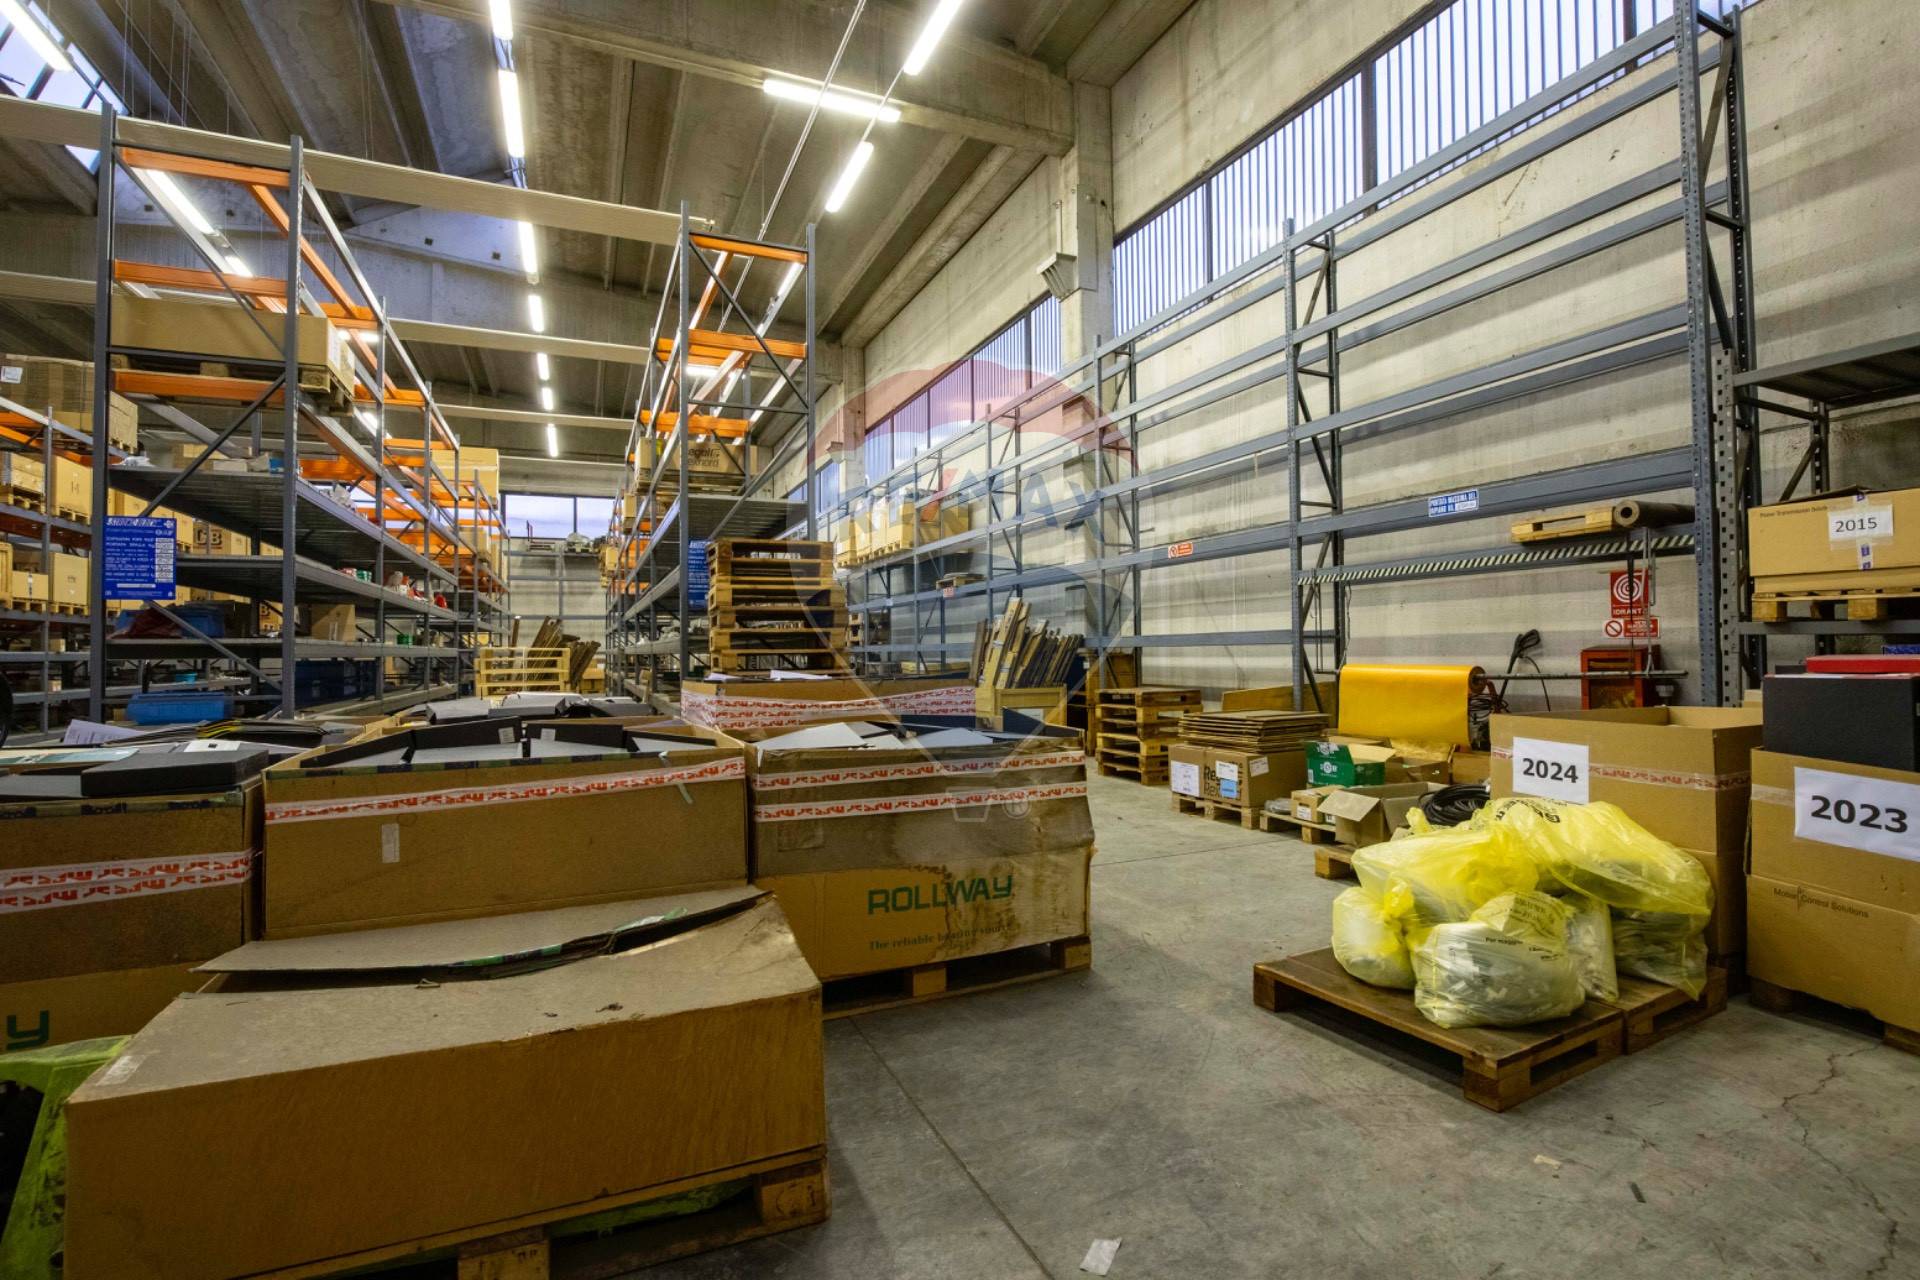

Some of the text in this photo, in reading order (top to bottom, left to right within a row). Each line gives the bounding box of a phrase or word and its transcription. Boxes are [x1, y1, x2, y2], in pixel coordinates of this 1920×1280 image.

[1834, 516, 1878, 534] 2015
[1613, 608, 1648, 616] IDRANT
[1522, 757, 1579, 784] 2024
[1811, 795, 1908, 834] 2023
[868, 874, 1013, 915] ROLLWAY
